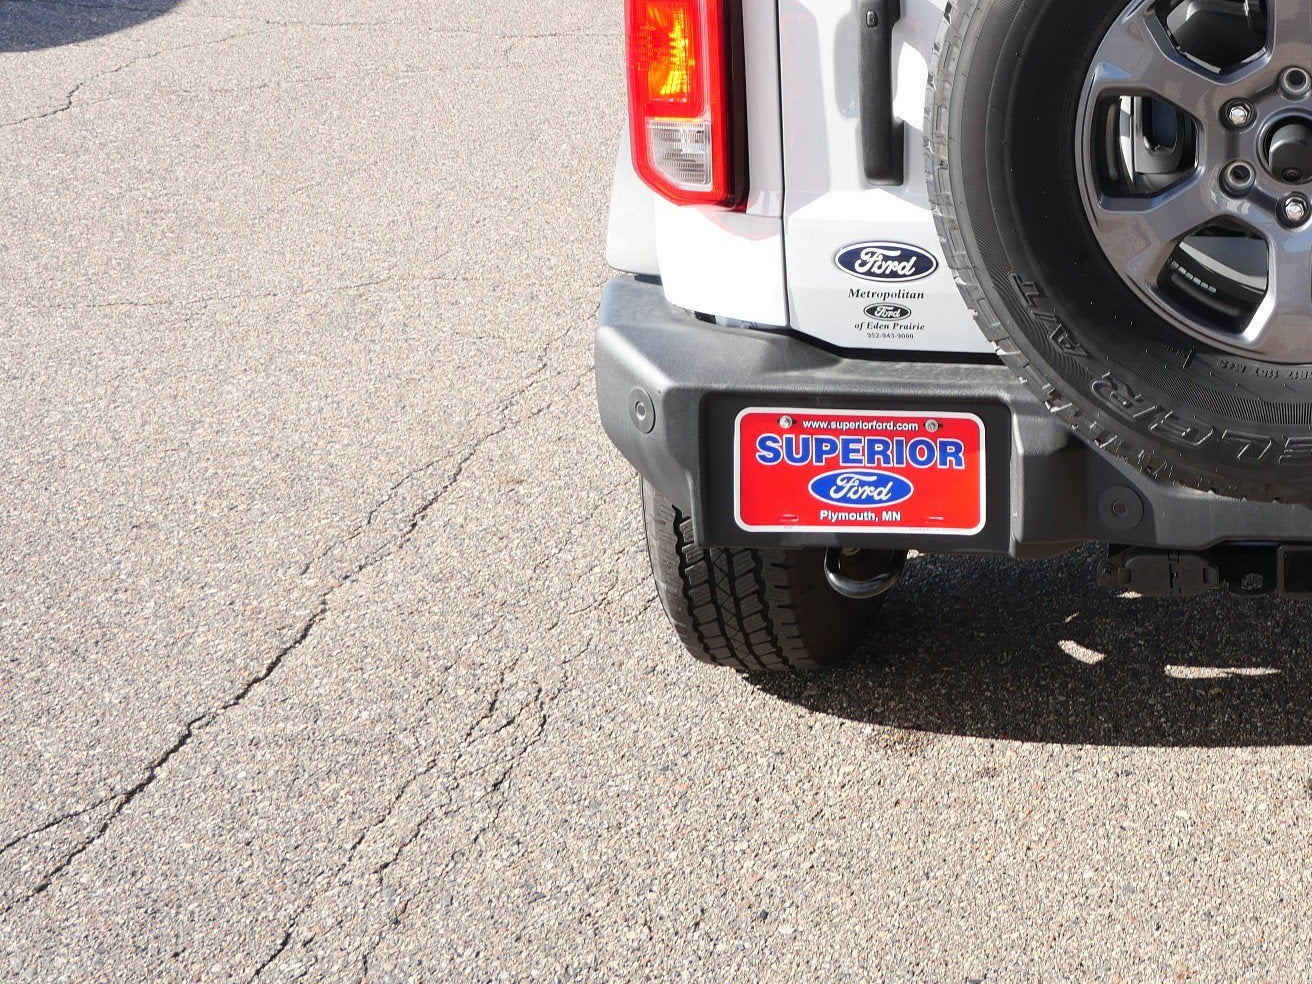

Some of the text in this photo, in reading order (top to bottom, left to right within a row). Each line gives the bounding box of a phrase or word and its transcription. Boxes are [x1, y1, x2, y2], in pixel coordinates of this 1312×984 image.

[855, 247, 917, 275] Ford
[848, 288, 925, 301] Metropolitan
[874, 306, 901, 318] Ford
[854, 321, 925, 331] of Eden Prairie
[803, 420, 919, 432] www.superiorford.com
[756, 433, 966, 470] SUPERIOR
[829, 473, 892, 501] Ford
[820, 510, 901, 522] Plymouth, MN
